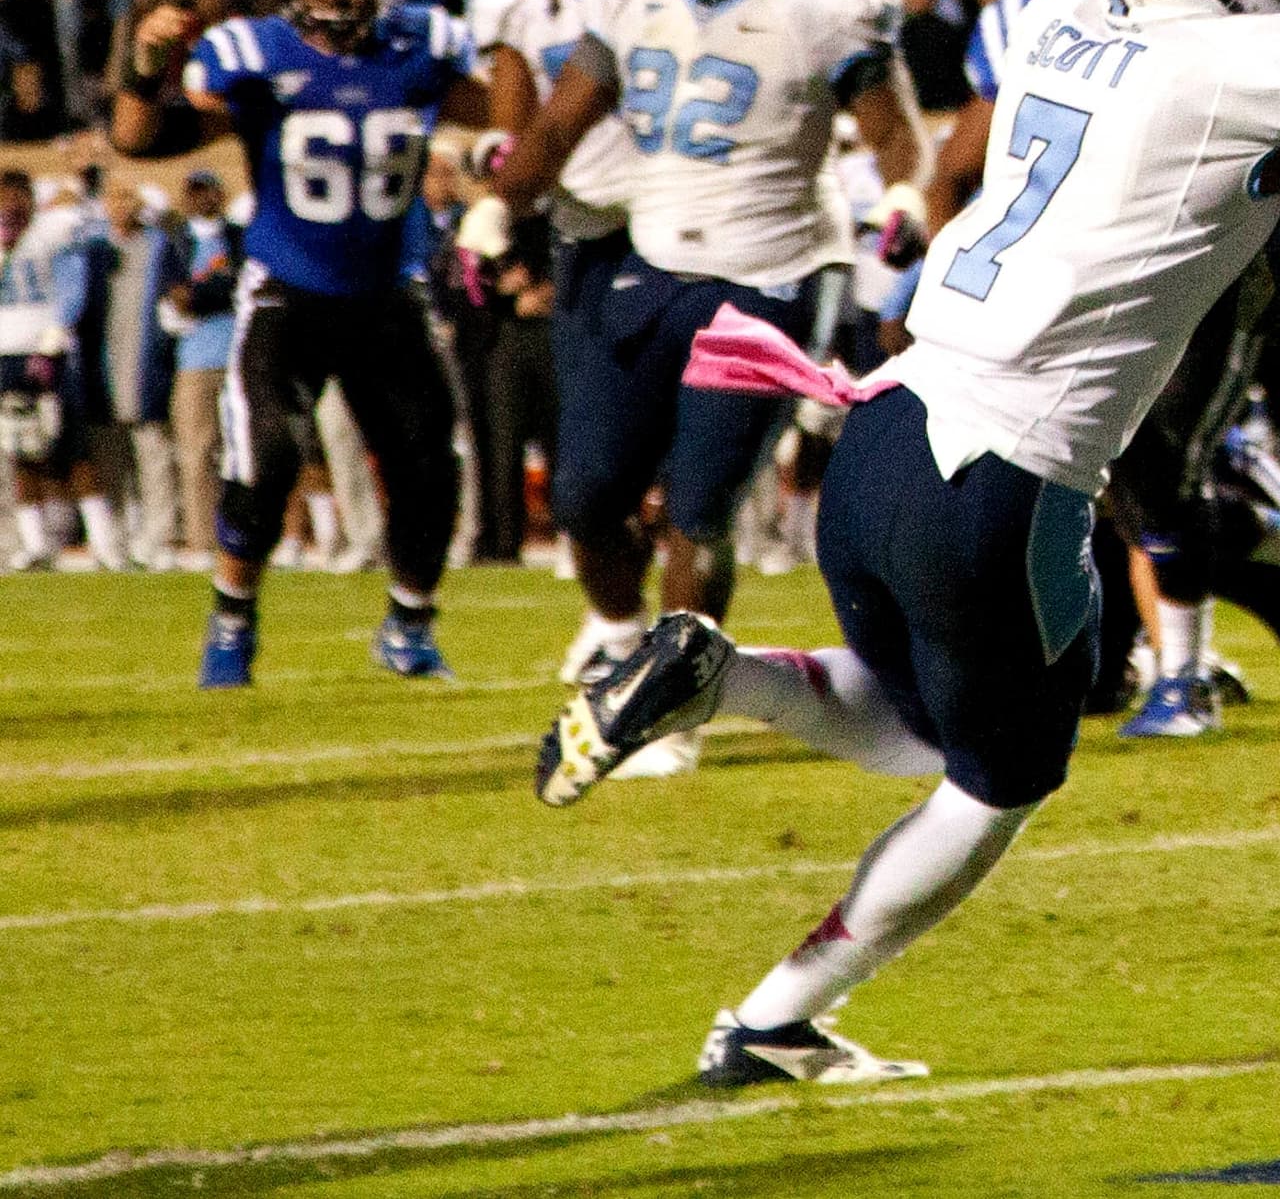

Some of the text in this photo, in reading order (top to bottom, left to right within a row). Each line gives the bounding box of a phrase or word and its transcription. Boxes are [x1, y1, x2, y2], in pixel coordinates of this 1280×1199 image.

[624, 47, 758, 165] 92
[1027, 19, 1147, 89] SCOTT
[942, 92, 1093, 302] 7
